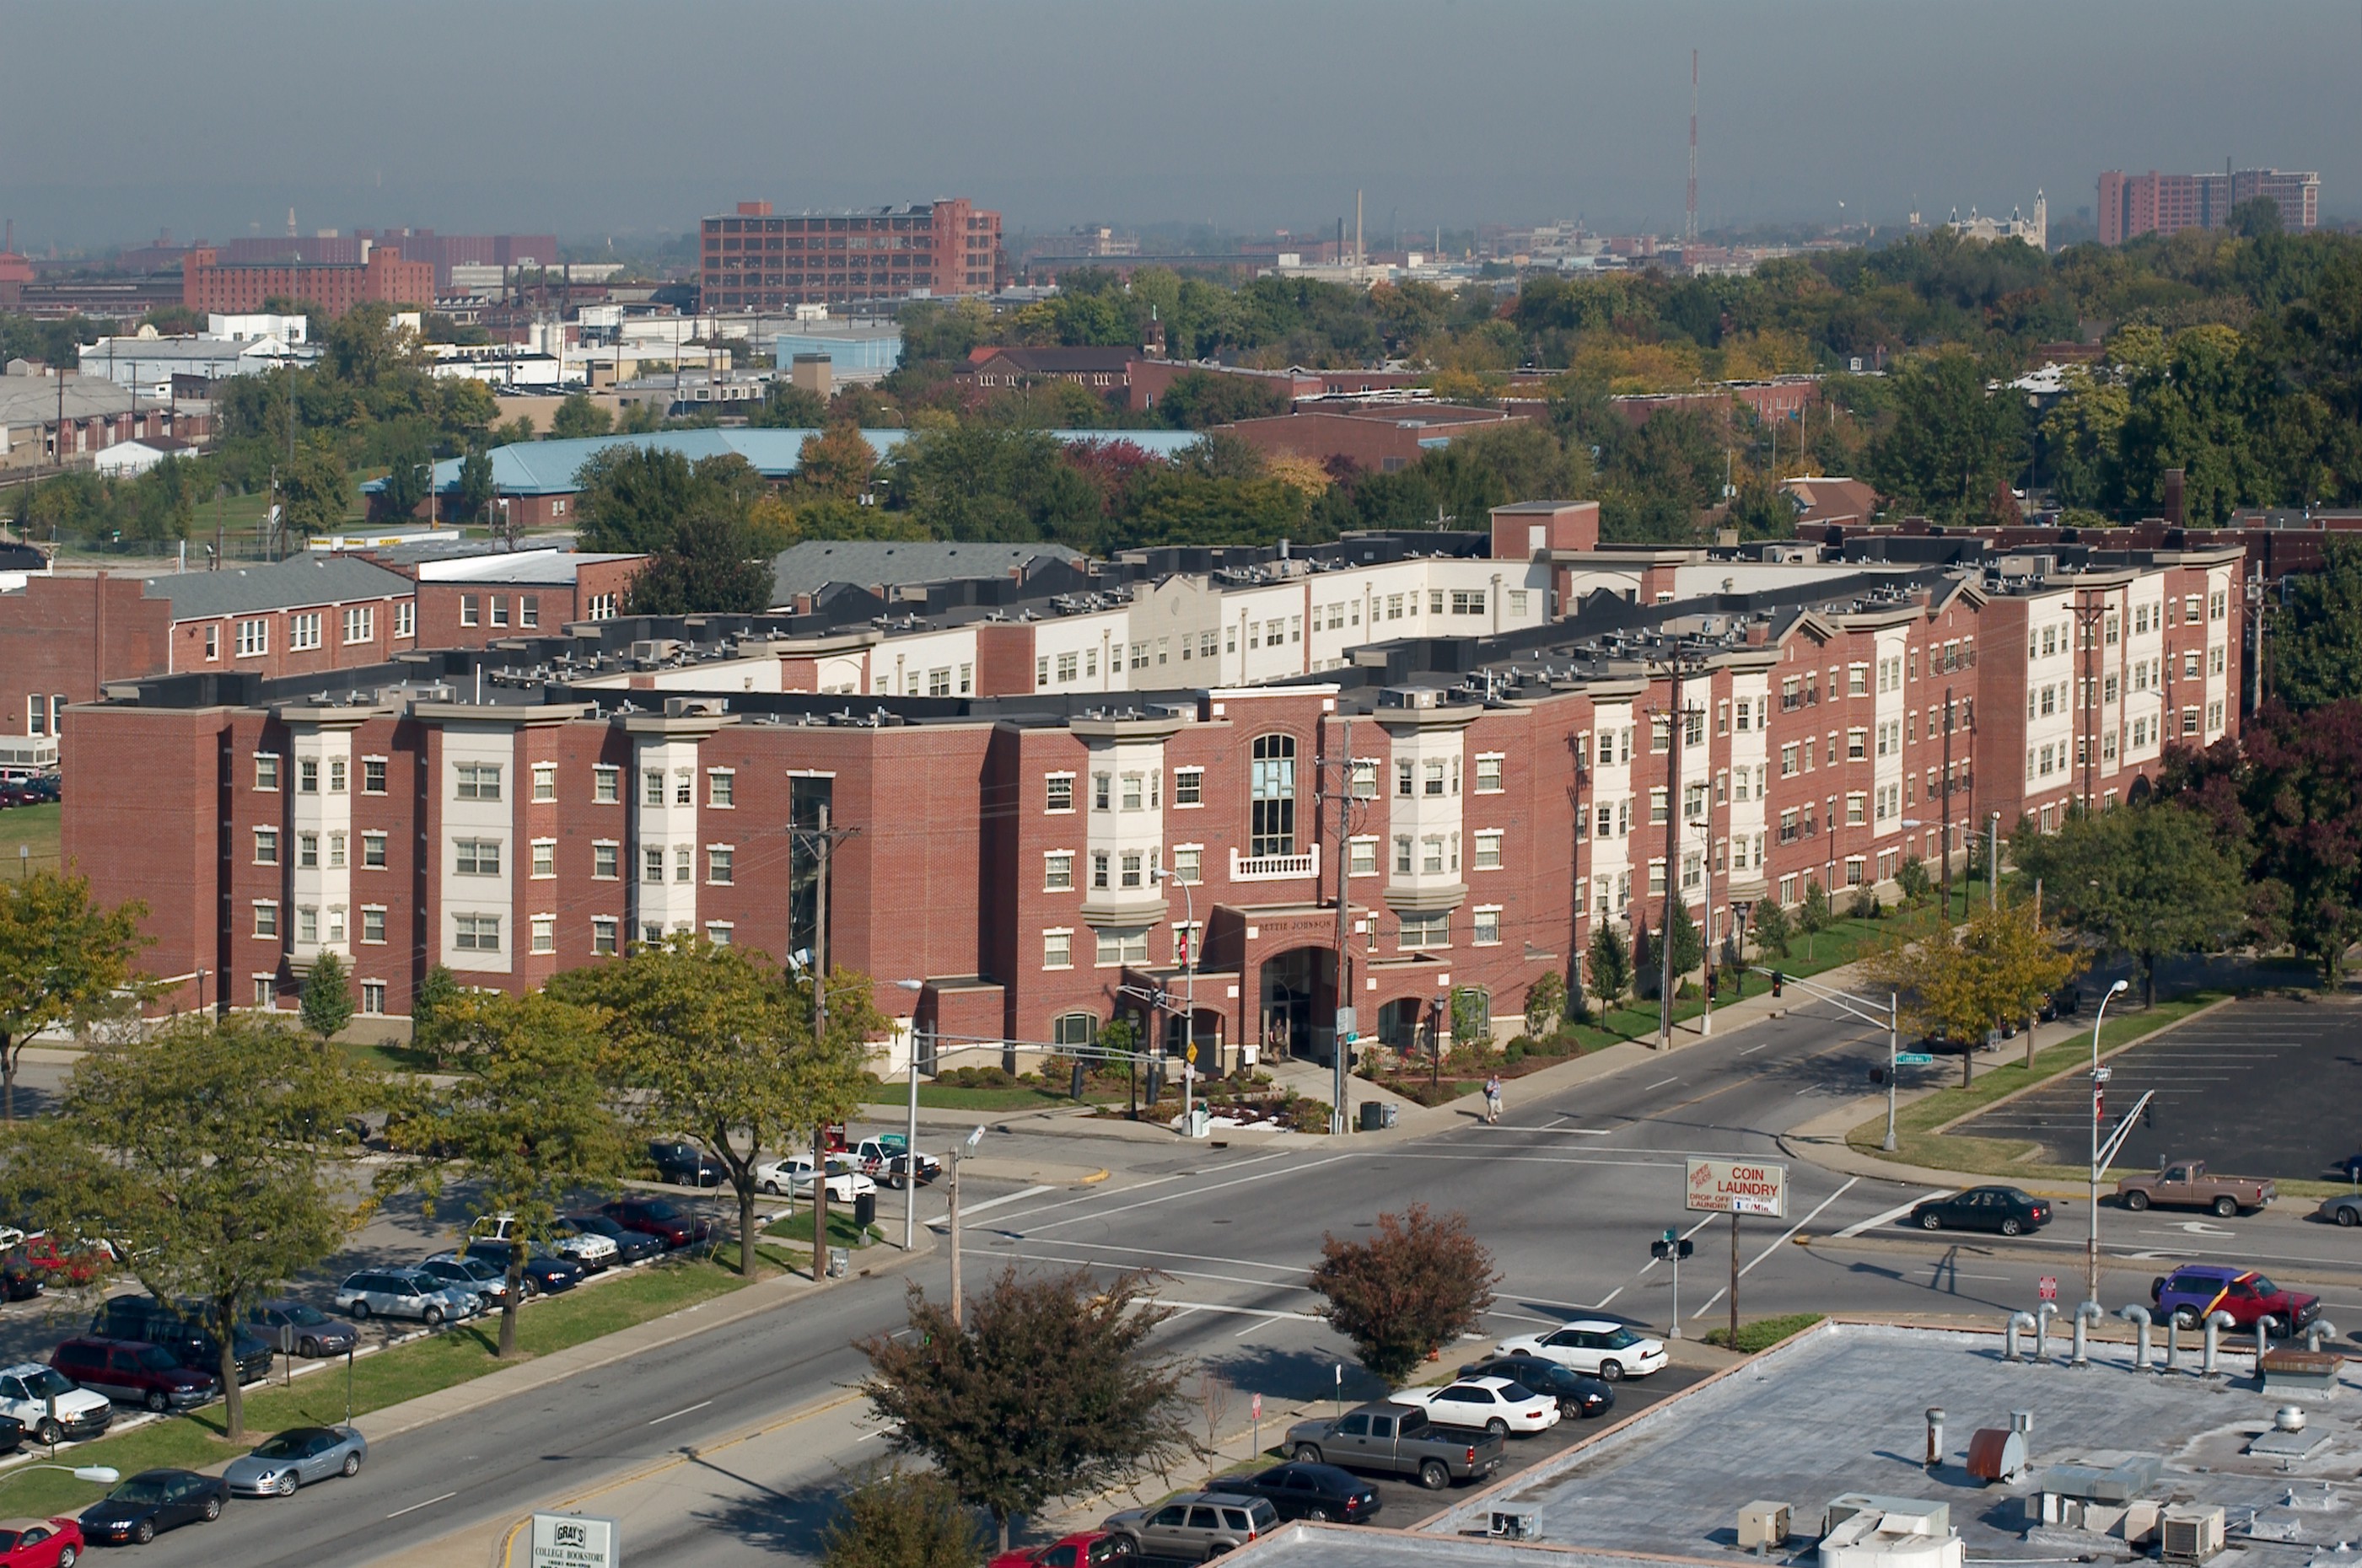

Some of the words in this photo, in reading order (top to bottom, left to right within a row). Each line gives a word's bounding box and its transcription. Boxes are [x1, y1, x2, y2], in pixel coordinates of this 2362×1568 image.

[1259, 923, 1288, 932] BETTIE
[1293, 921, 1332, 930] JOHNSON
[1732, 1168, 1763, 1180] COIN
[1718, 1180, 1778, 1195] LAUNDRY
[557, 1526, 584, 1542] GRAY'S
[535, 1547, 563, 1558] COLLEGE
[567, 1551, 605, 1562] BOOKSTORE
